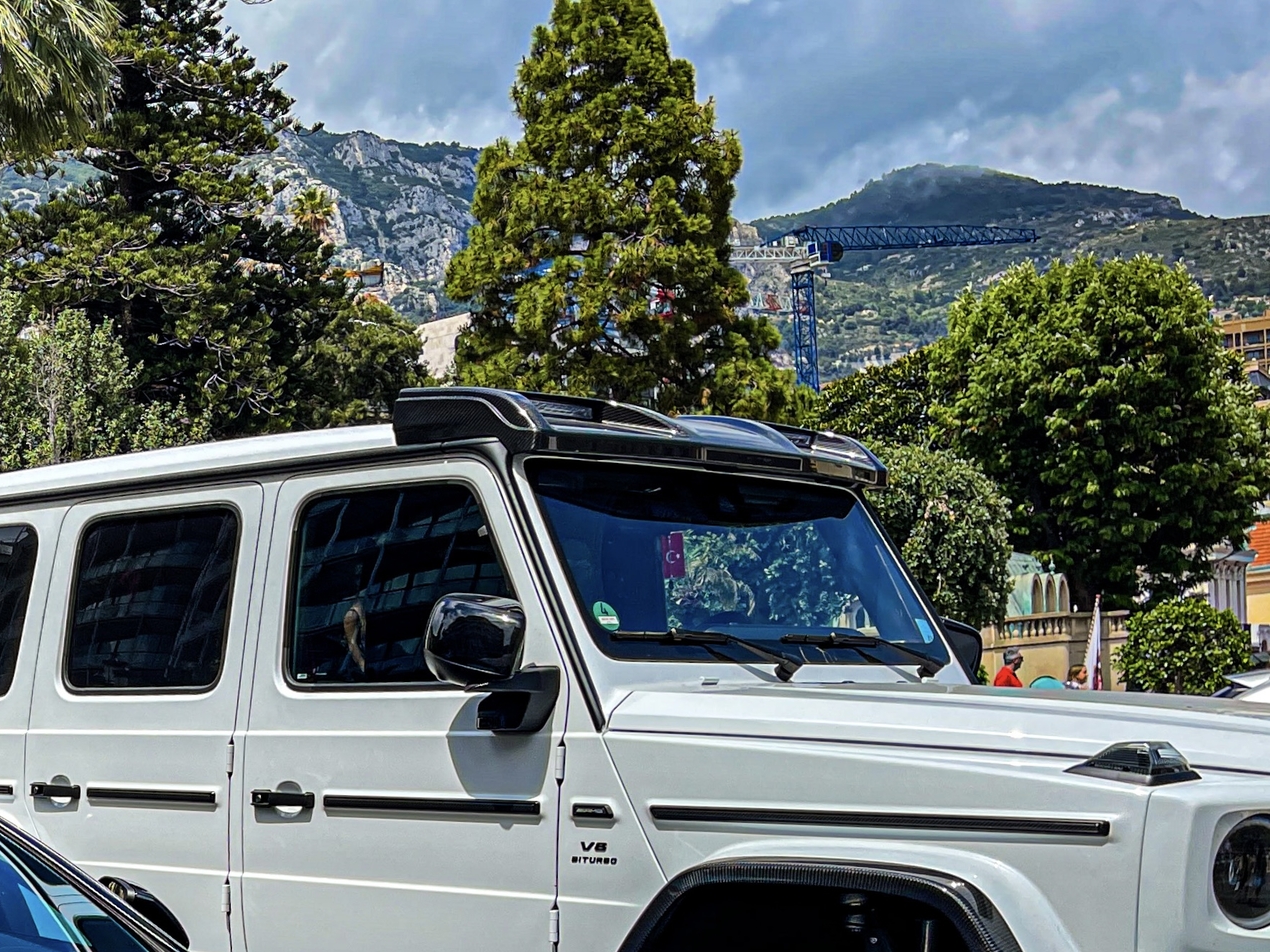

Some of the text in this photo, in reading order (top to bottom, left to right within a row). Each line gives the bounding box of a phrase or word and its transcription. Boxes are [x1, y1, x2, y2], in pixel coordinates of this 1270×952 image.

[600, 602, 609, 616] 4
[580, 841, 608, 852] V8
[571, 856, 618, 866] BITURBO
